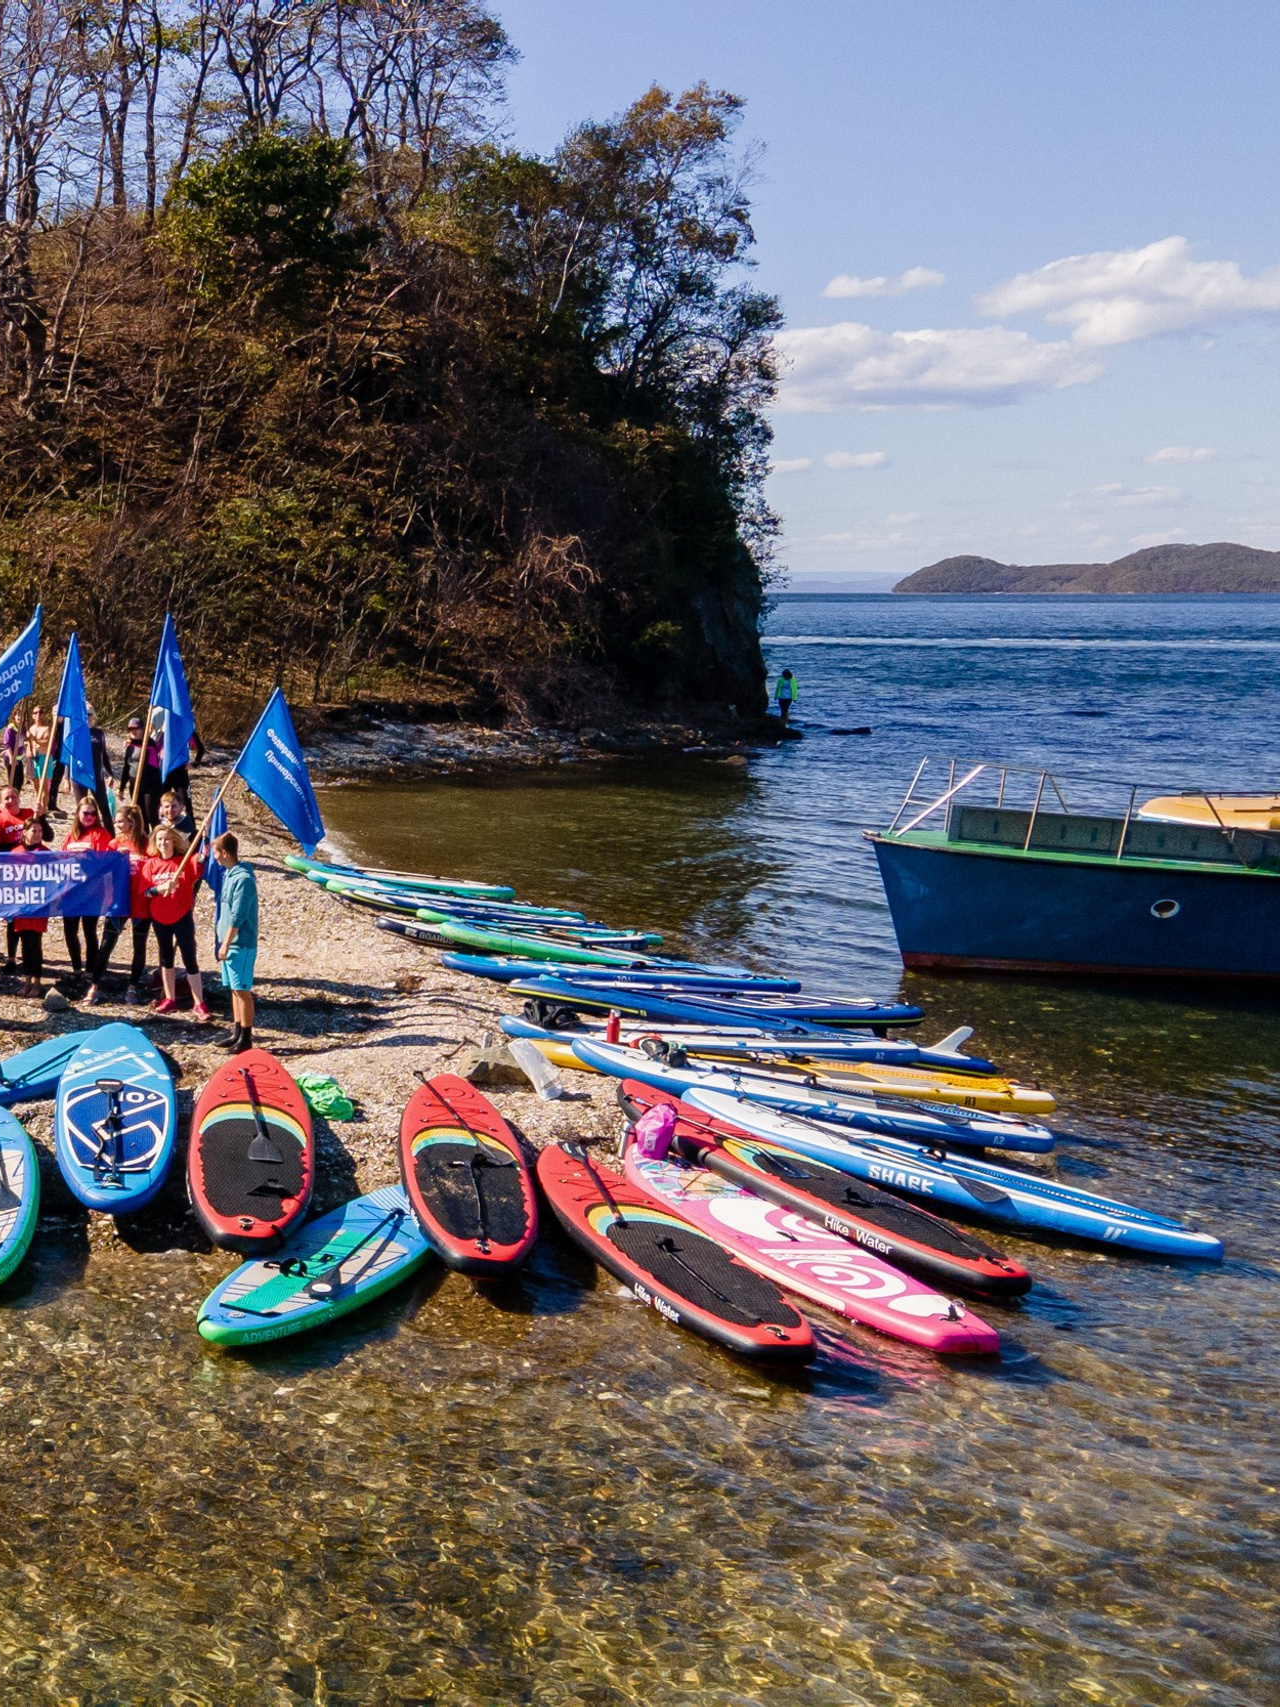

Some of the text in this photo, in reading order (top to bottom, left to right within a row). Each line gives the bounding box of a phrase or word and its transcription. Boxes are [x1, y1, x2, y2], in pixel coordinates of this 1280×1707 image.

[868, 1164, 935, 1194] SHARK
[824, 1215, 850, 1238] Hike
[855, 1229, 894, 1255] Water
[241, 1321, 303, 1344] ADVENTURE
